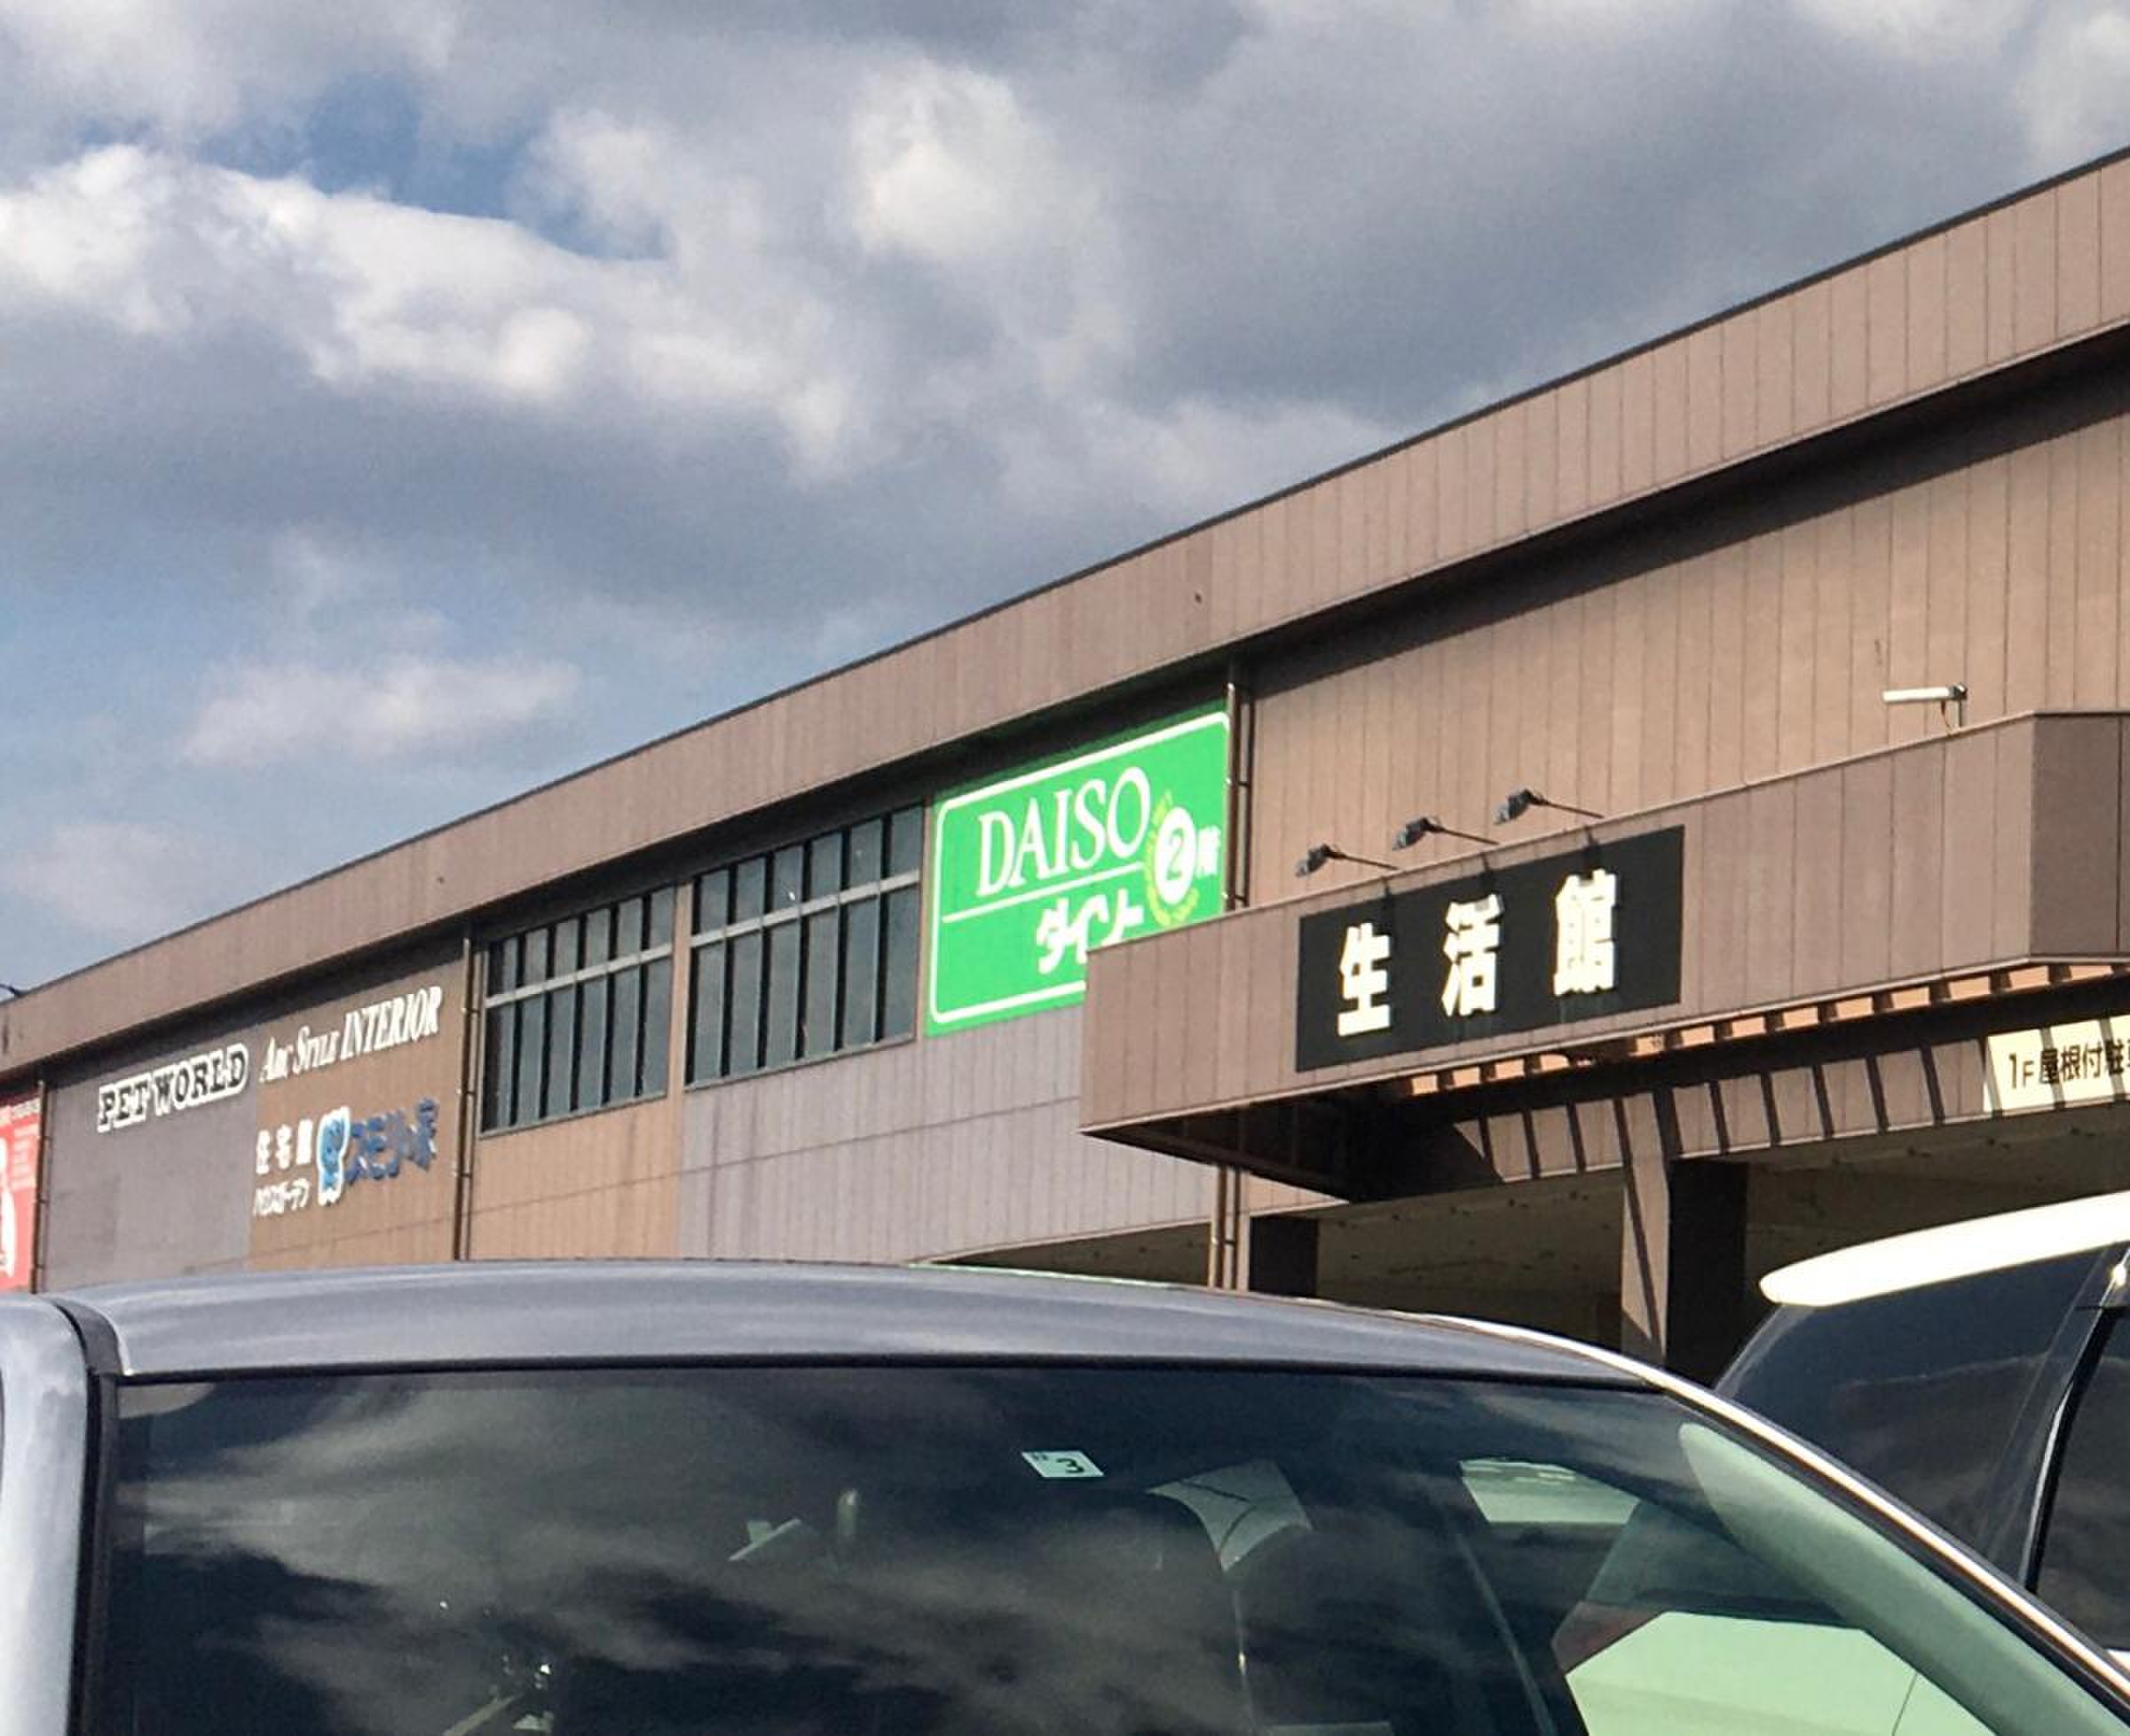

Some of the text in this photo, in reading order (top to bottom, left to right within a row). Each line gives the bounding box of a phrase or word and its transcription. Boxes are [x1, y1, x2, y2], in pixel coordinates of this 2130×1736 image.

[976, 767, 1151, 897] DAISO
[1337, 867, 1619, 1038] 生活館
[340, 985, 443, 1061] INTERIOR
[2008, 1038, 2130, 1090] 1F屋根付駐
[98, 1043, 249, 1133] PET WORLD
[1056, 1457, 1085, 1473] 3
